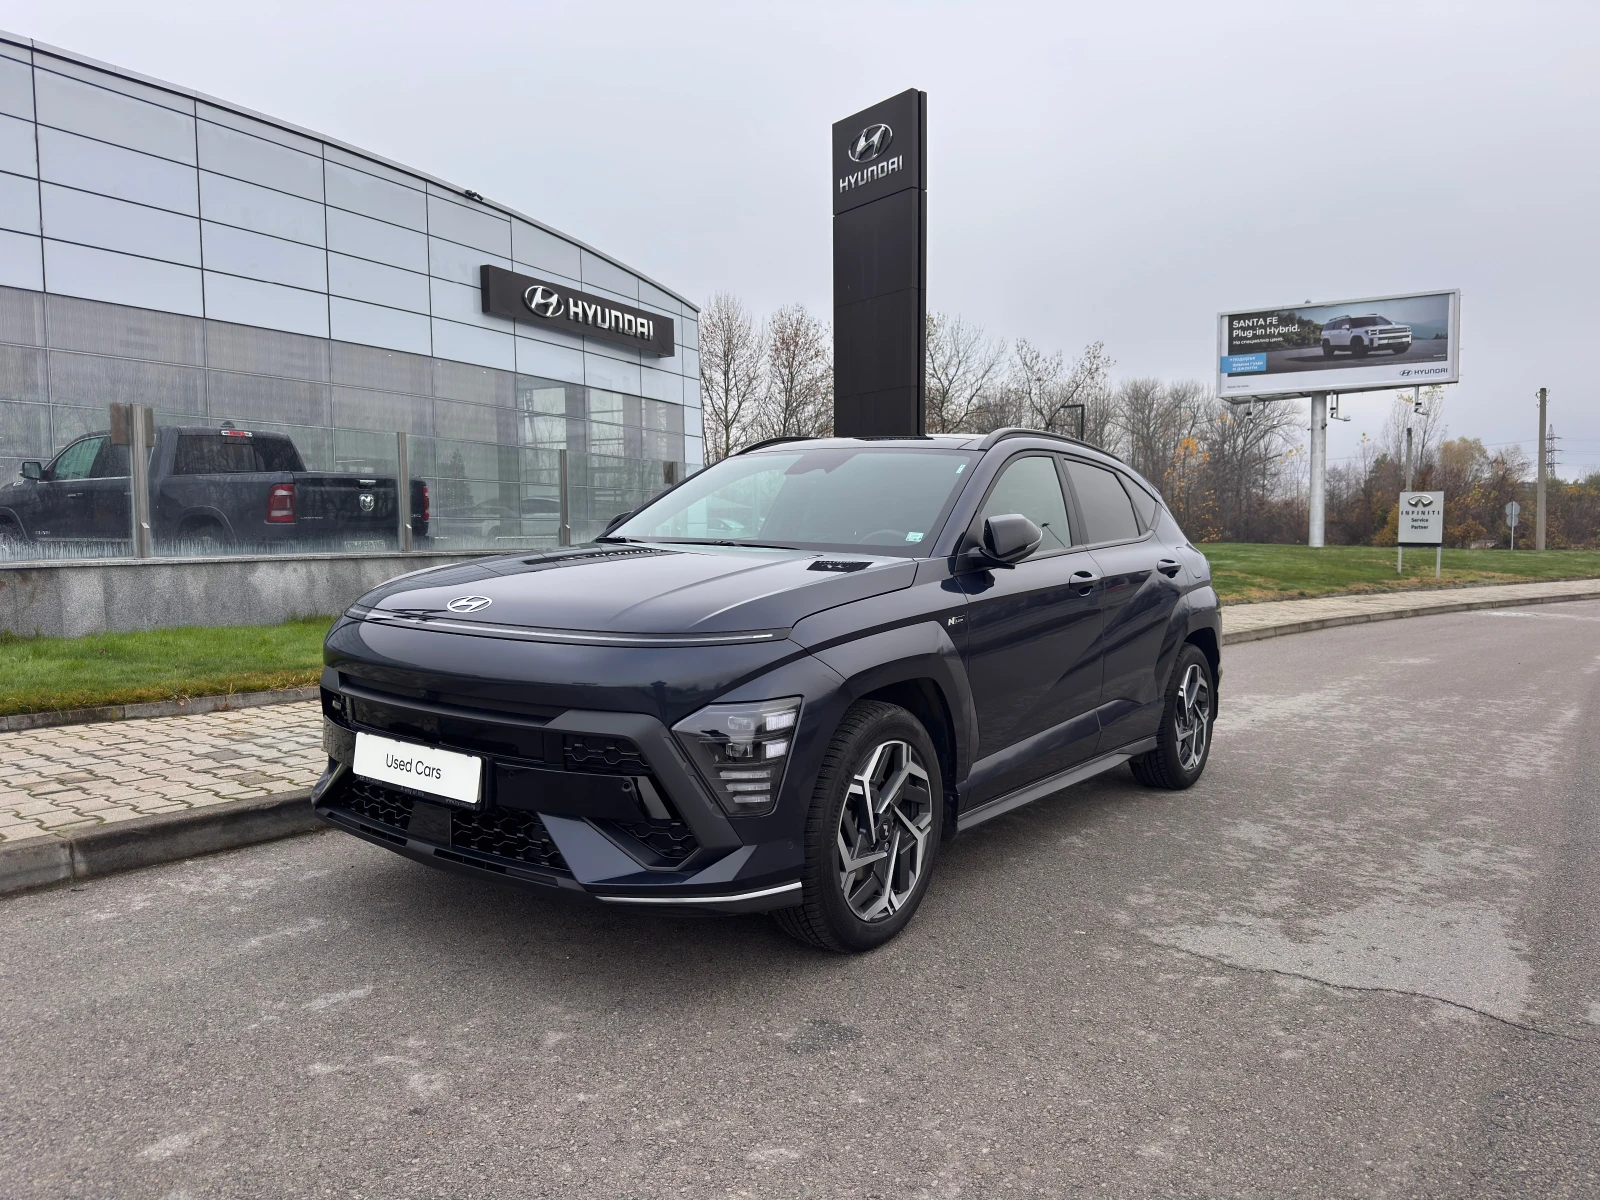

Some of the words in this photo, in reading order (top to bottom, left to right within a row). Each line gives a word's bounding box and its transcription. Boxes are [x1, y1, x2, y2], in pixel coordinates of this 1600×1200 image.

[840, 155, 902, 193] HYUNDAI
[568, 297, 653, 341] HYUNDAI
[1233, 318, 1265, 328] SANTA
[1233, 328, 1265, 337] Plug-in
[1267, 324, 1300, 335] Hybrid.
[386, 753, 412, 773] Used
[415, 760, 442, 779] Cars
